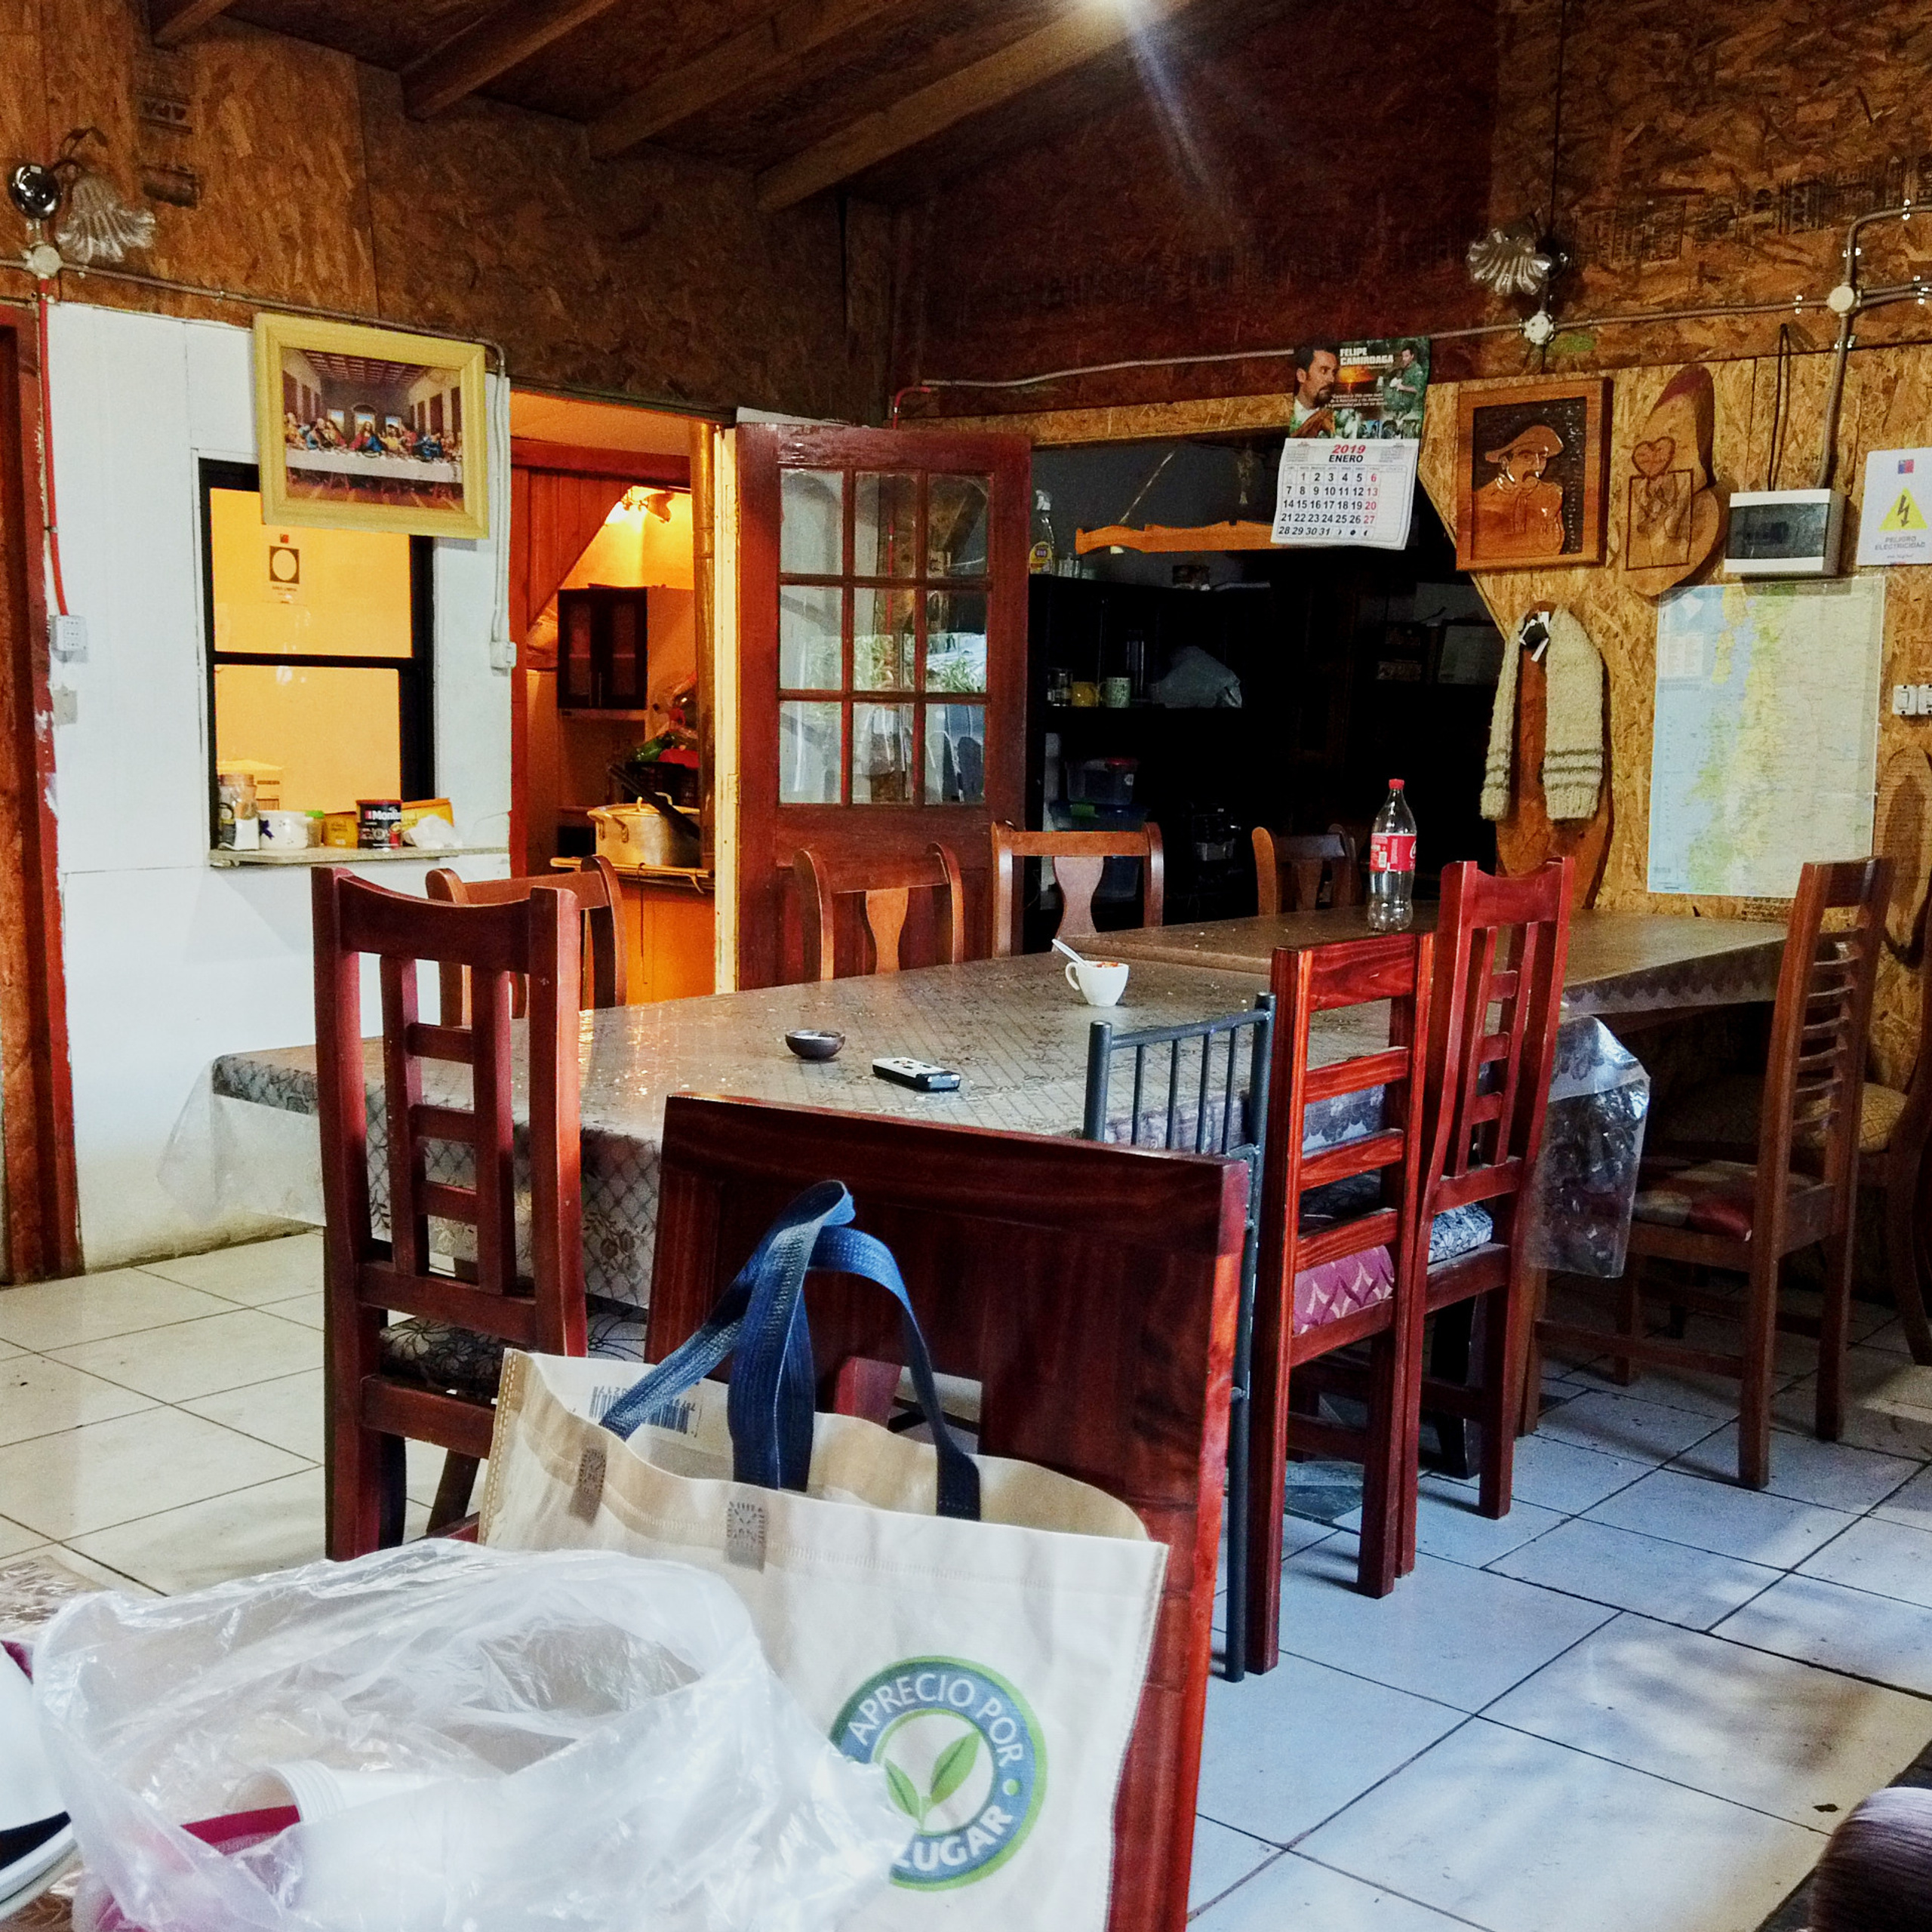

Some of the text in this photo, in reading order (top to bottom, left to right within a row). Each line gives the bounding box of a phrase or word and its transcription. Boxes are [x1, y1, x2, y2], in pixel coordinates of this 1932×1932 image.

[1340, 347, 1367, 357] FELIPE
[1340, 355, 1395, 367] CAMIROAGA
[1331, 444, 1366, 454] 2019
[1328, 454, 1364, 463] ENERO
[1301, 472, 1377, 482] 1 2 3 4 5 6
[1286, 485, 1379, 497] 7 8 9 10 11 12 13
[1283, 499, 1377, 510] 14 15 16 17 18 19 20
[1281, 512, 1376, 525] 21 22 23 24 25 26 27
[1278, 526, 1331, 536] 28 29 30 31
[1875, 541, 1925, 550] ELECTRICIDAD
[848, 1672, 1023, 1767] APRECIO POR
